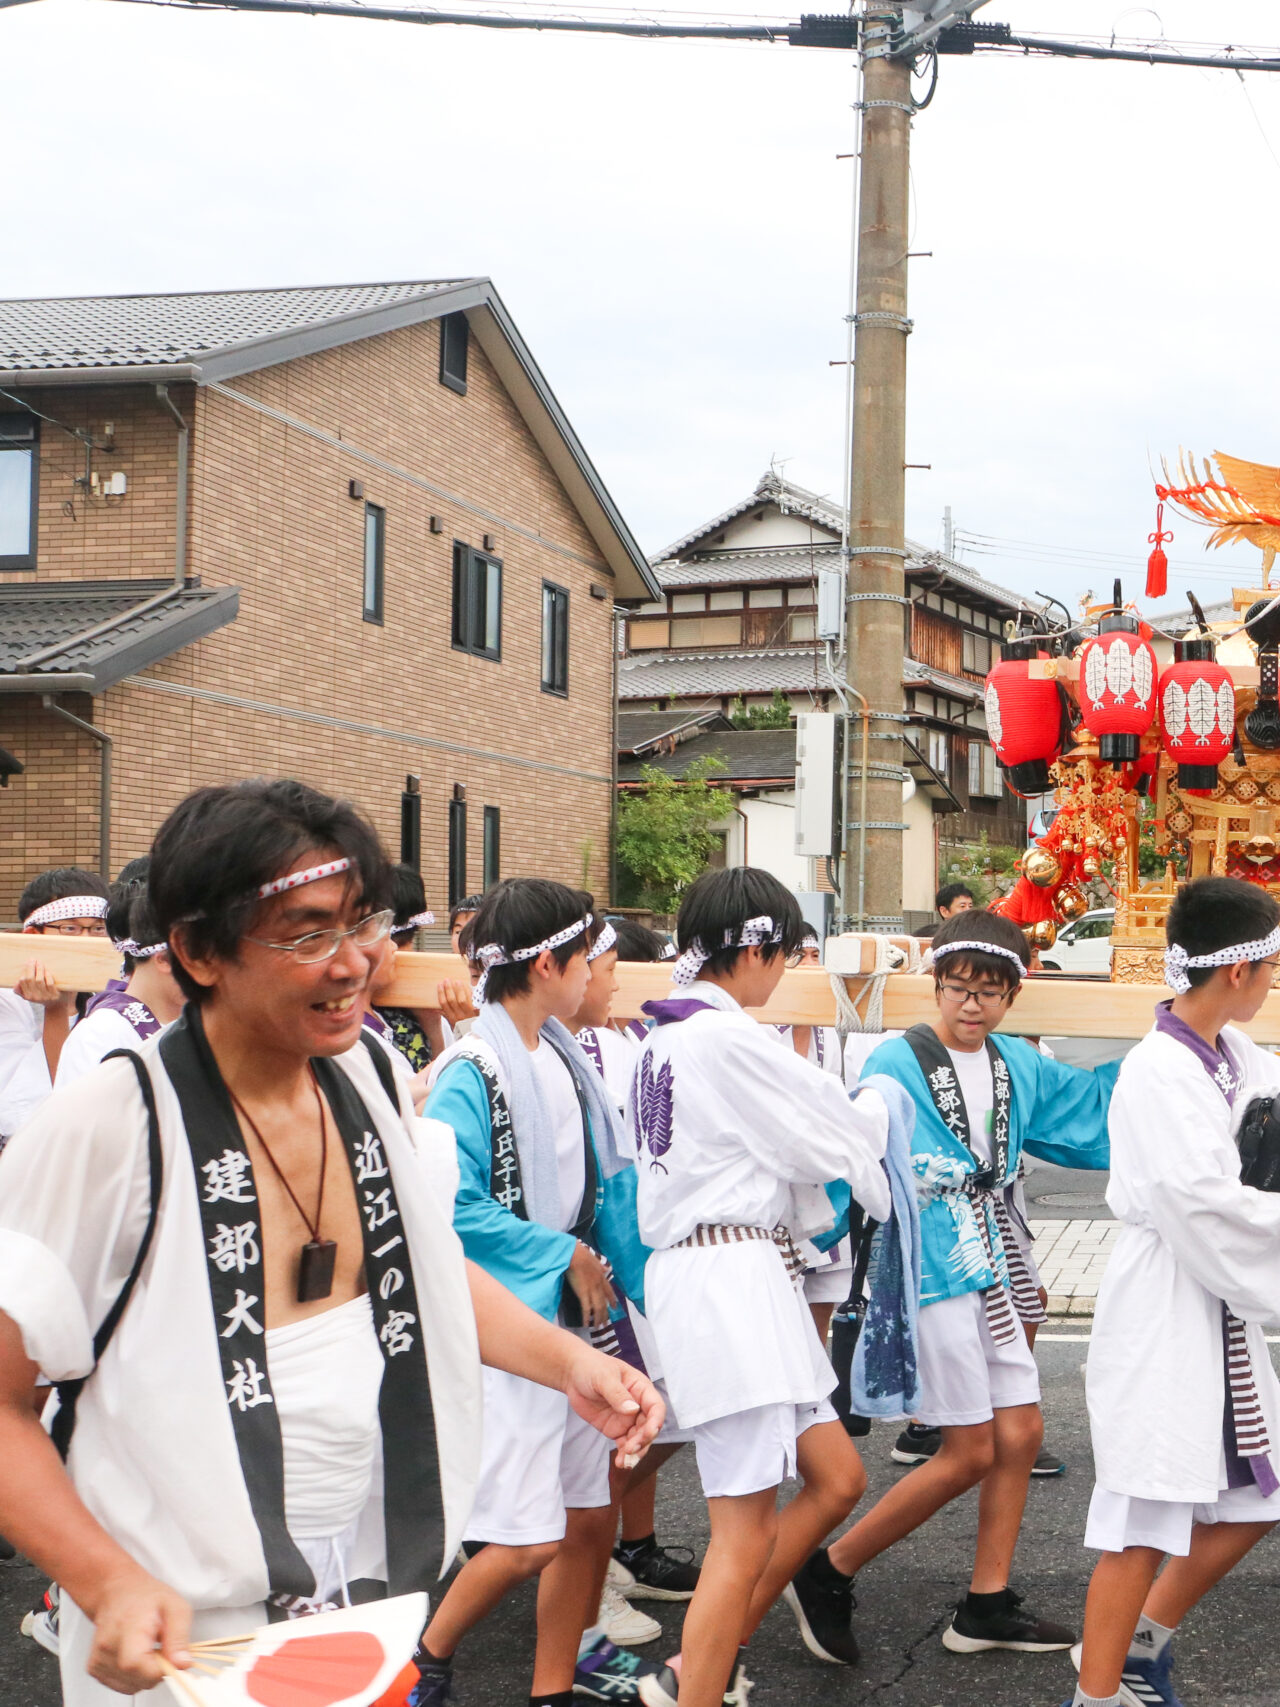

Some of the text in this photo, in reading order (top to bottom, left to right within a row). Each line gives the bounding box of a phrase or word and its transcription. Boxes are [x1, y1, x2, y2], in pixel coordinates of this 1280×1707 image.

[200, 1149, 274, 1412] 建部大社
[353, 1131, 416, 1357] 近江一の宮
